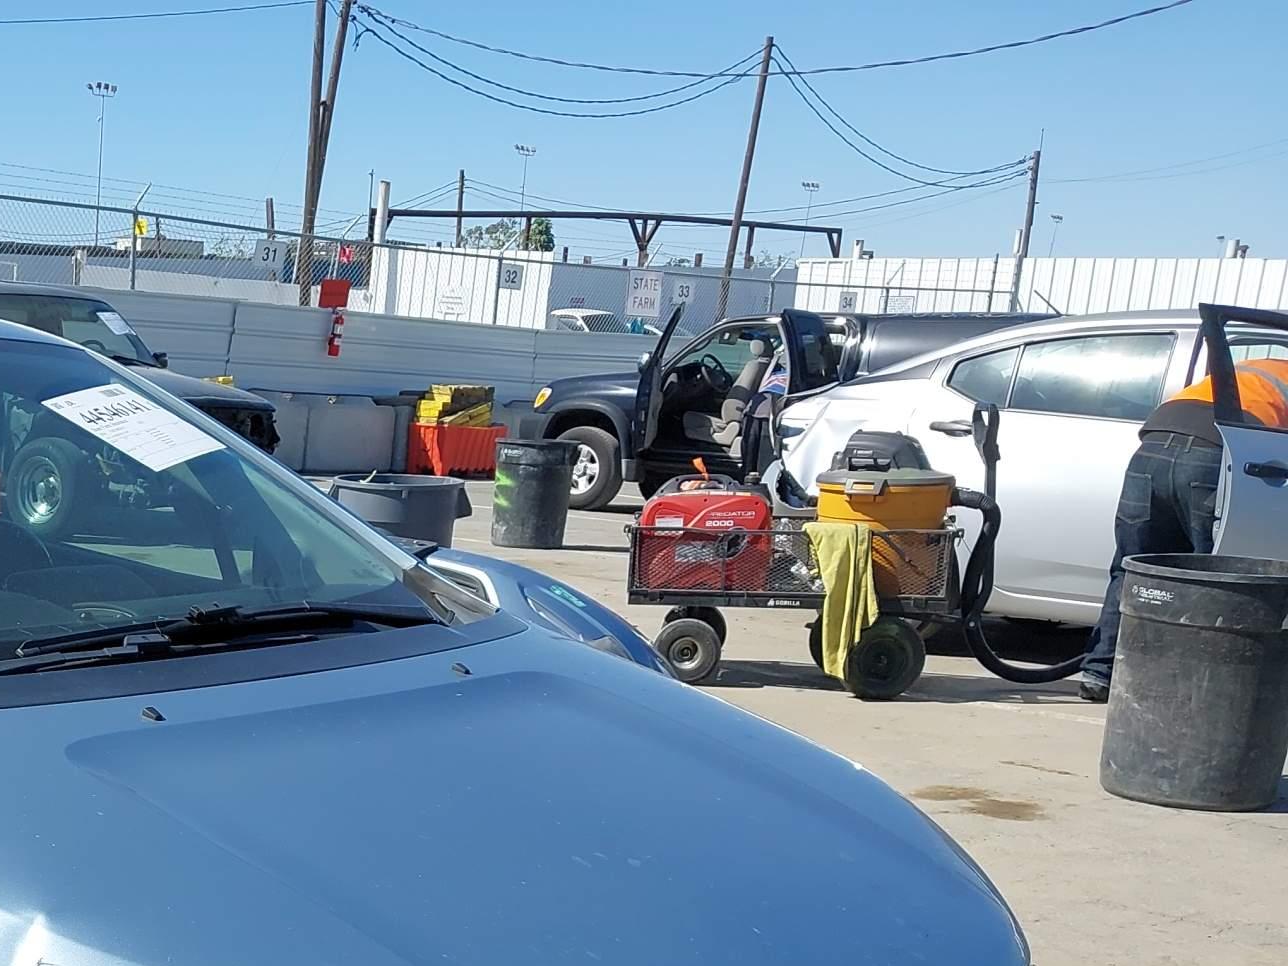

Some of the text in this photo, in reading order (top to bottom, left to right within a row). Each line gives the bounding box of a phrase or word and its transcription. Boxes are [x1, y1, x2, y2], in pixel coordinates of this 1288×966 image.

[262, 246, 277, 263] 31
[504, 269, 518, 284] 32
[633, 277, 660, 291] STATE
[678, 285, 690, 298] 33
[632, 296, 656, 309] FARM
[842, 297, 853, 309] 34
[78, 399, 151, 425] 44546141
[1139, 586, 1175, 598] GLOBAL
